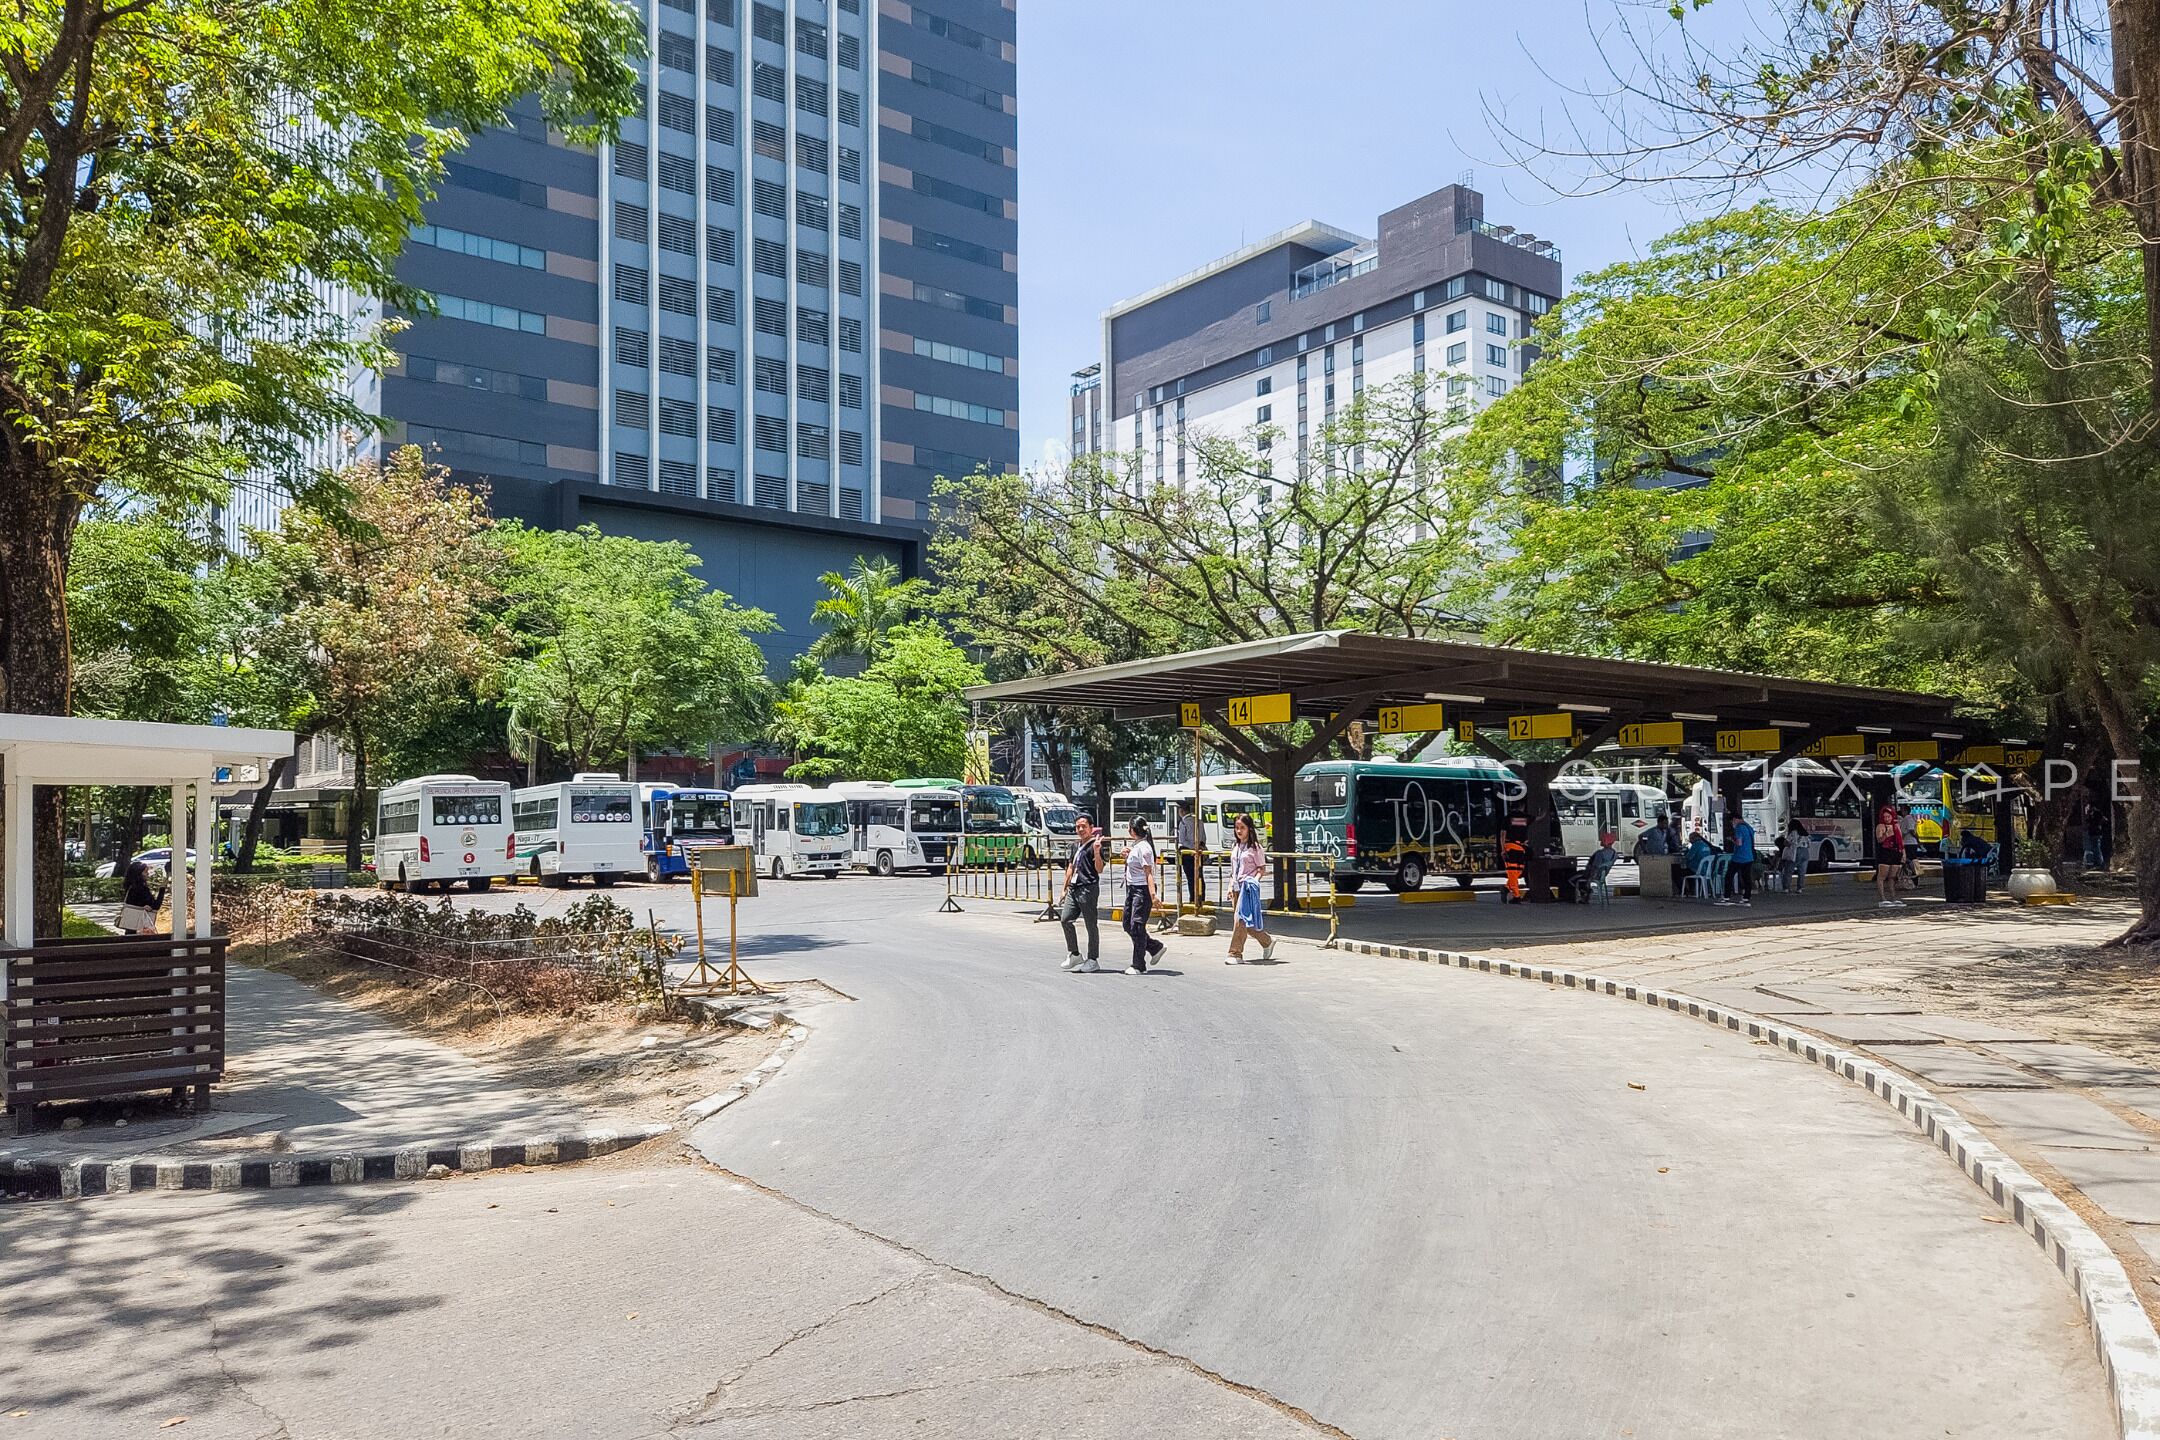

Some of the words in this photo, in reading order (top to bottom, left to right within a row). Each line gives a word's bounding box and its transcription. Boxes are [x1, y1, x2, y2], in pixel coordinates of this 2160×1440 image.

[1184, 708, 1198, 721] 14
[1231, 701, 1248, 721] 14
[1381, 711, 1399, 729] 13
[1462, 725, 1472, 737] 12
[1511, 720, 1528, 737] 12
[1621, 727, 1639, 743] 11
[1719, 734, 1736, 749] 10
[1878, 745, 1896, 758] 08
[2006, 754, 2024, 765] 06
[1385, 781, 1465, 864] TOPS
[1308, 824, 1341, 857] TOPS
[465, 854, 472, 862] 5
